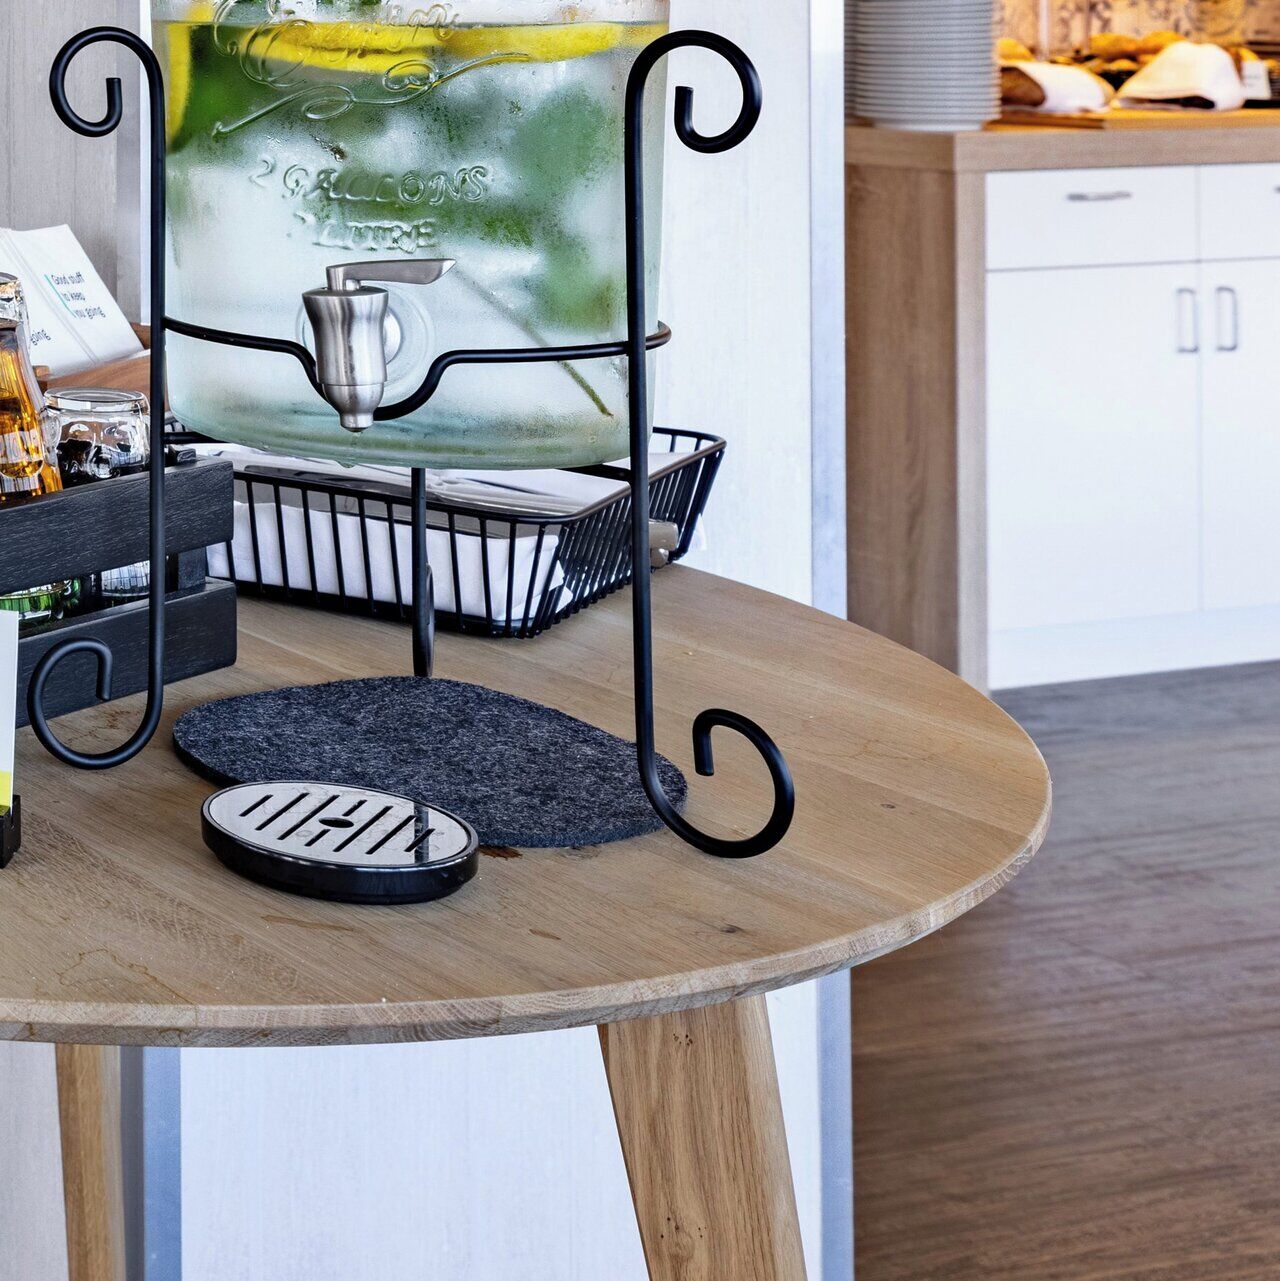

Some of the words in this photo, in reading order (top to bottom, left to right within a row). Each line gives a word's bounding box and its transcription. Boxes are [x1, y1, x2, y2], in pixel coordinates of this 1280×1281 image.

[283, 164, 489, 207] GALLONS
[51, 274, 70, 285] Good
[85, 307, 106, 320] going
